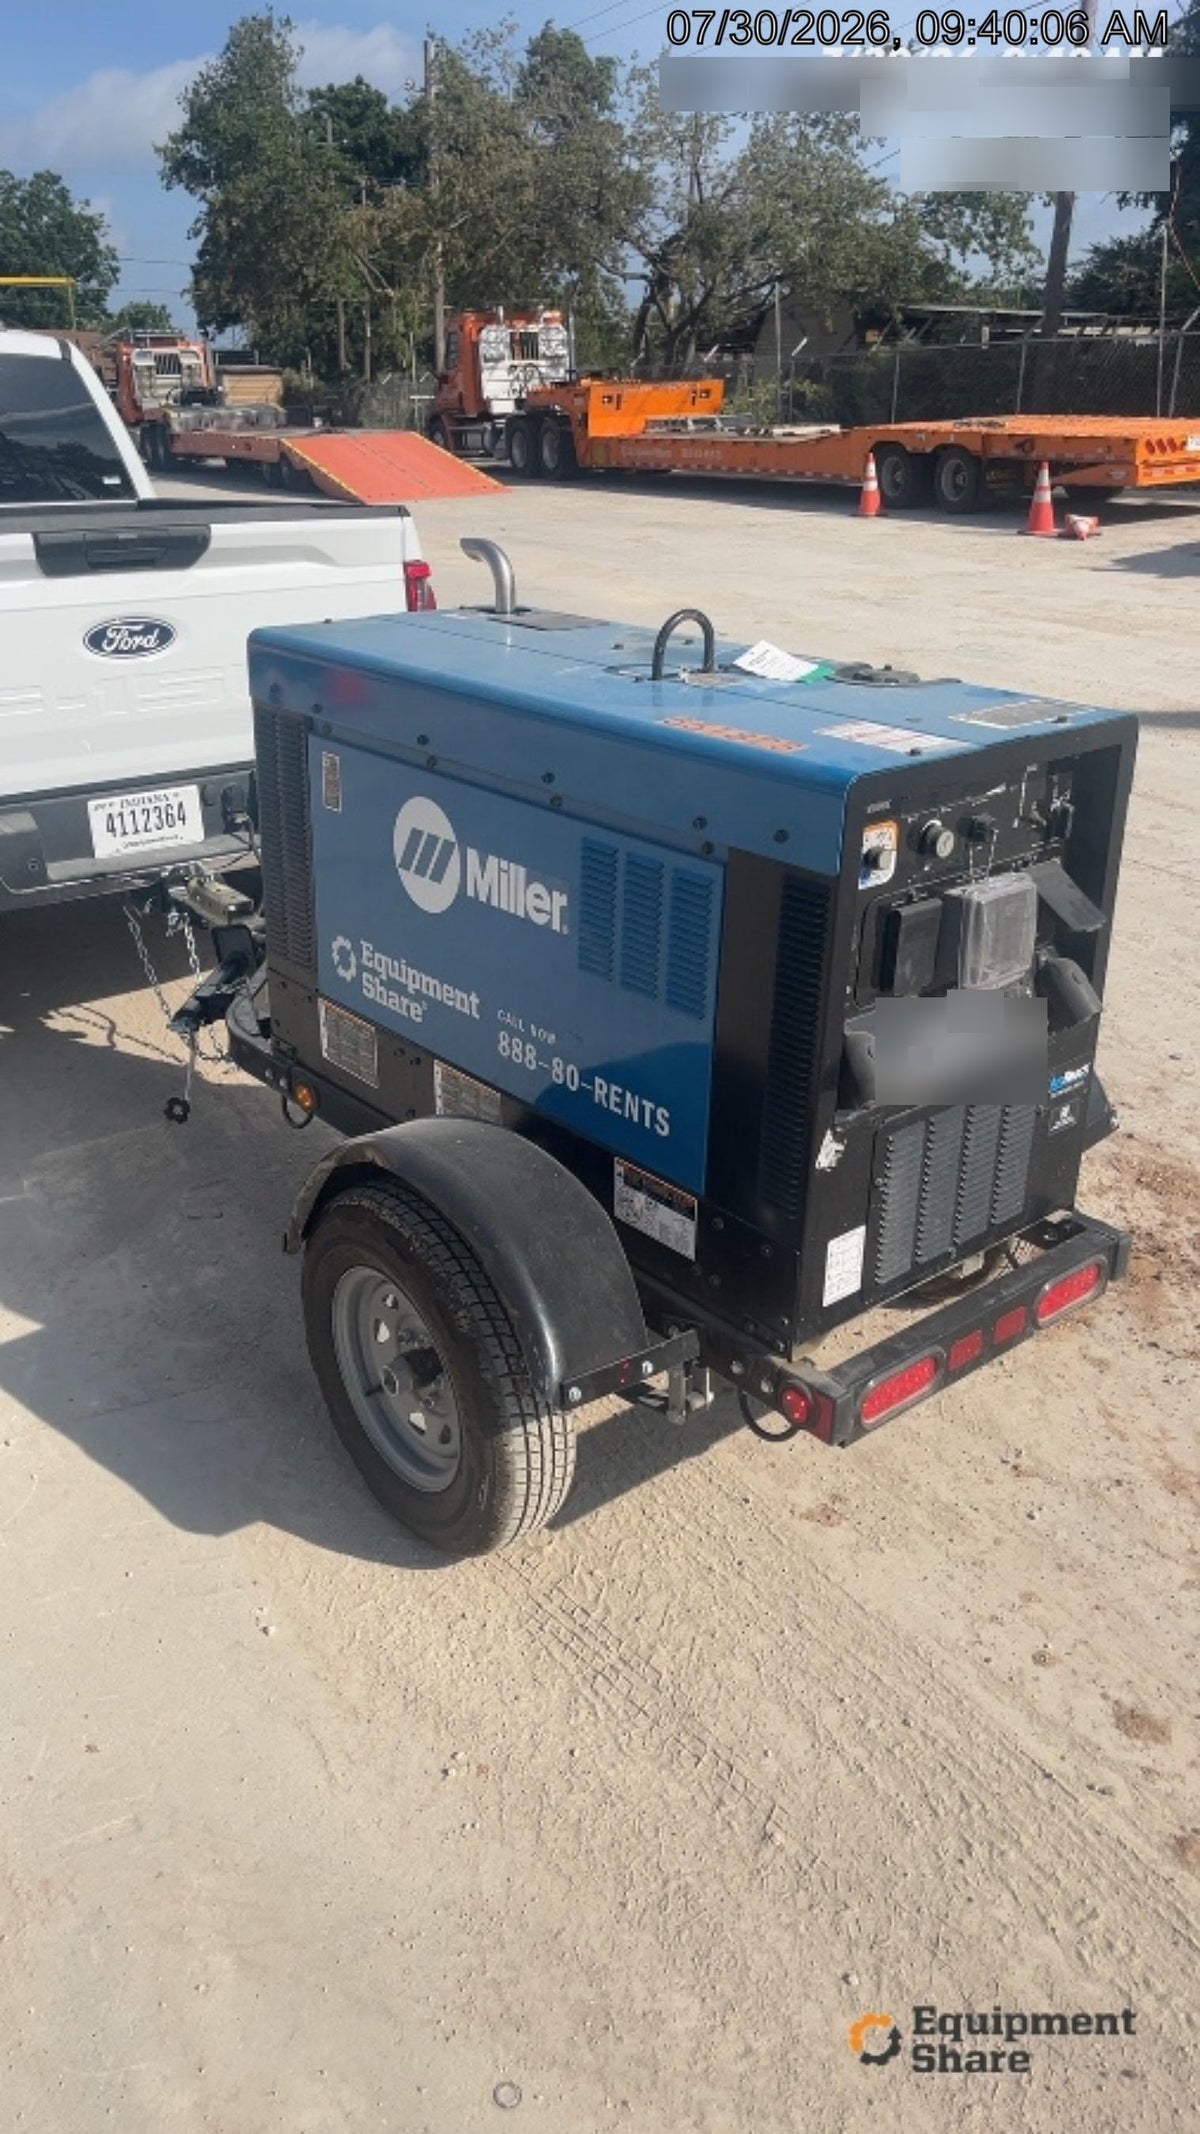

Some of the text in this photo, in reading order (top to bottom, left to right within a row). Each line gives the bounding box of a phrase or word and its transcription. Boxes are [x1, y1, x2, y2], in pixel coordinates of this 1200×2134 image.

[102, 623, 159, 652] Ford
[105, 800, 187, 838] 4112364
[466, 845, 568, 933] Miller
[360, 938, 481, 1021] Equipment
[497, 1009, 526, 1033] CALL
[498, 1030, 671, 1137] 888-80-RENTS
